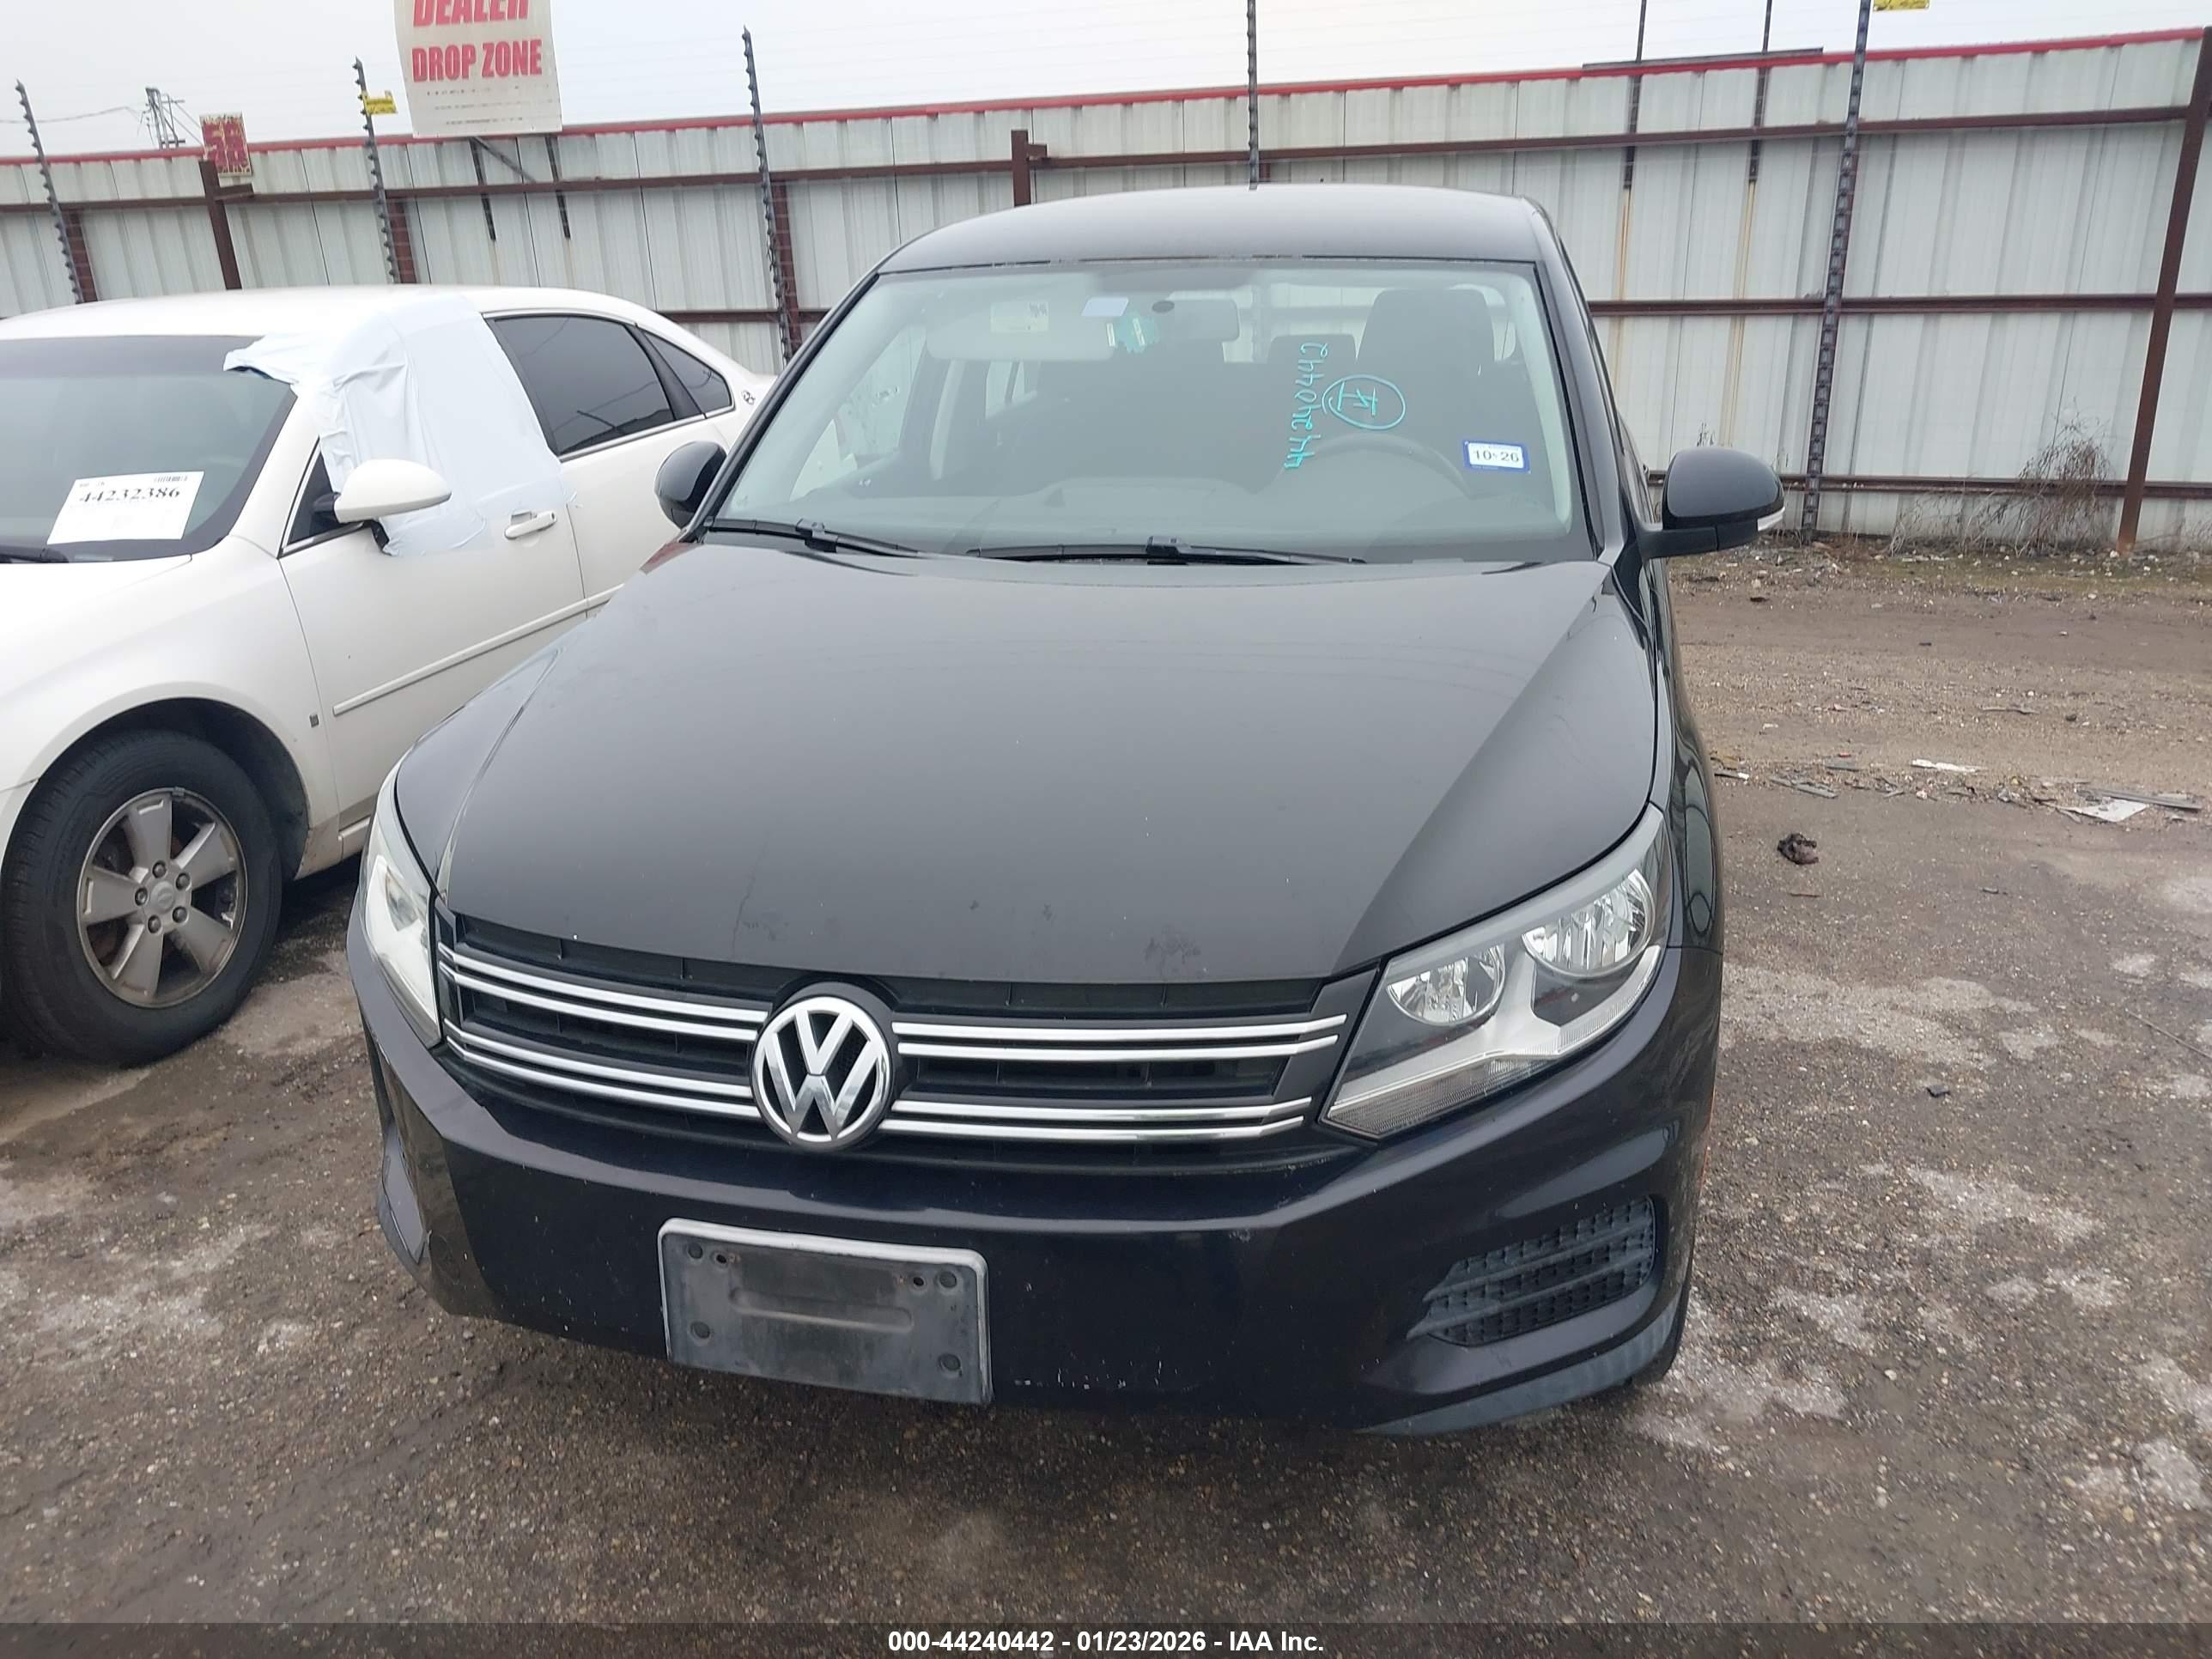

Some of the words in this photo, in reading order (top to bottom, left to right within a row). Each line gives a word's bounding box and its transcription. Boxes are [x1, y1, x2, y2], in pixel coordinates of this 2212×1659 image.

[412, 0, 530, 27] DEALER
[411, 44, 477, 82] DROP
[481, 39, 543, 78] ZONE
[79, 487, 181, 502] 44232386
[757, 1000, 885, 1145] VW
